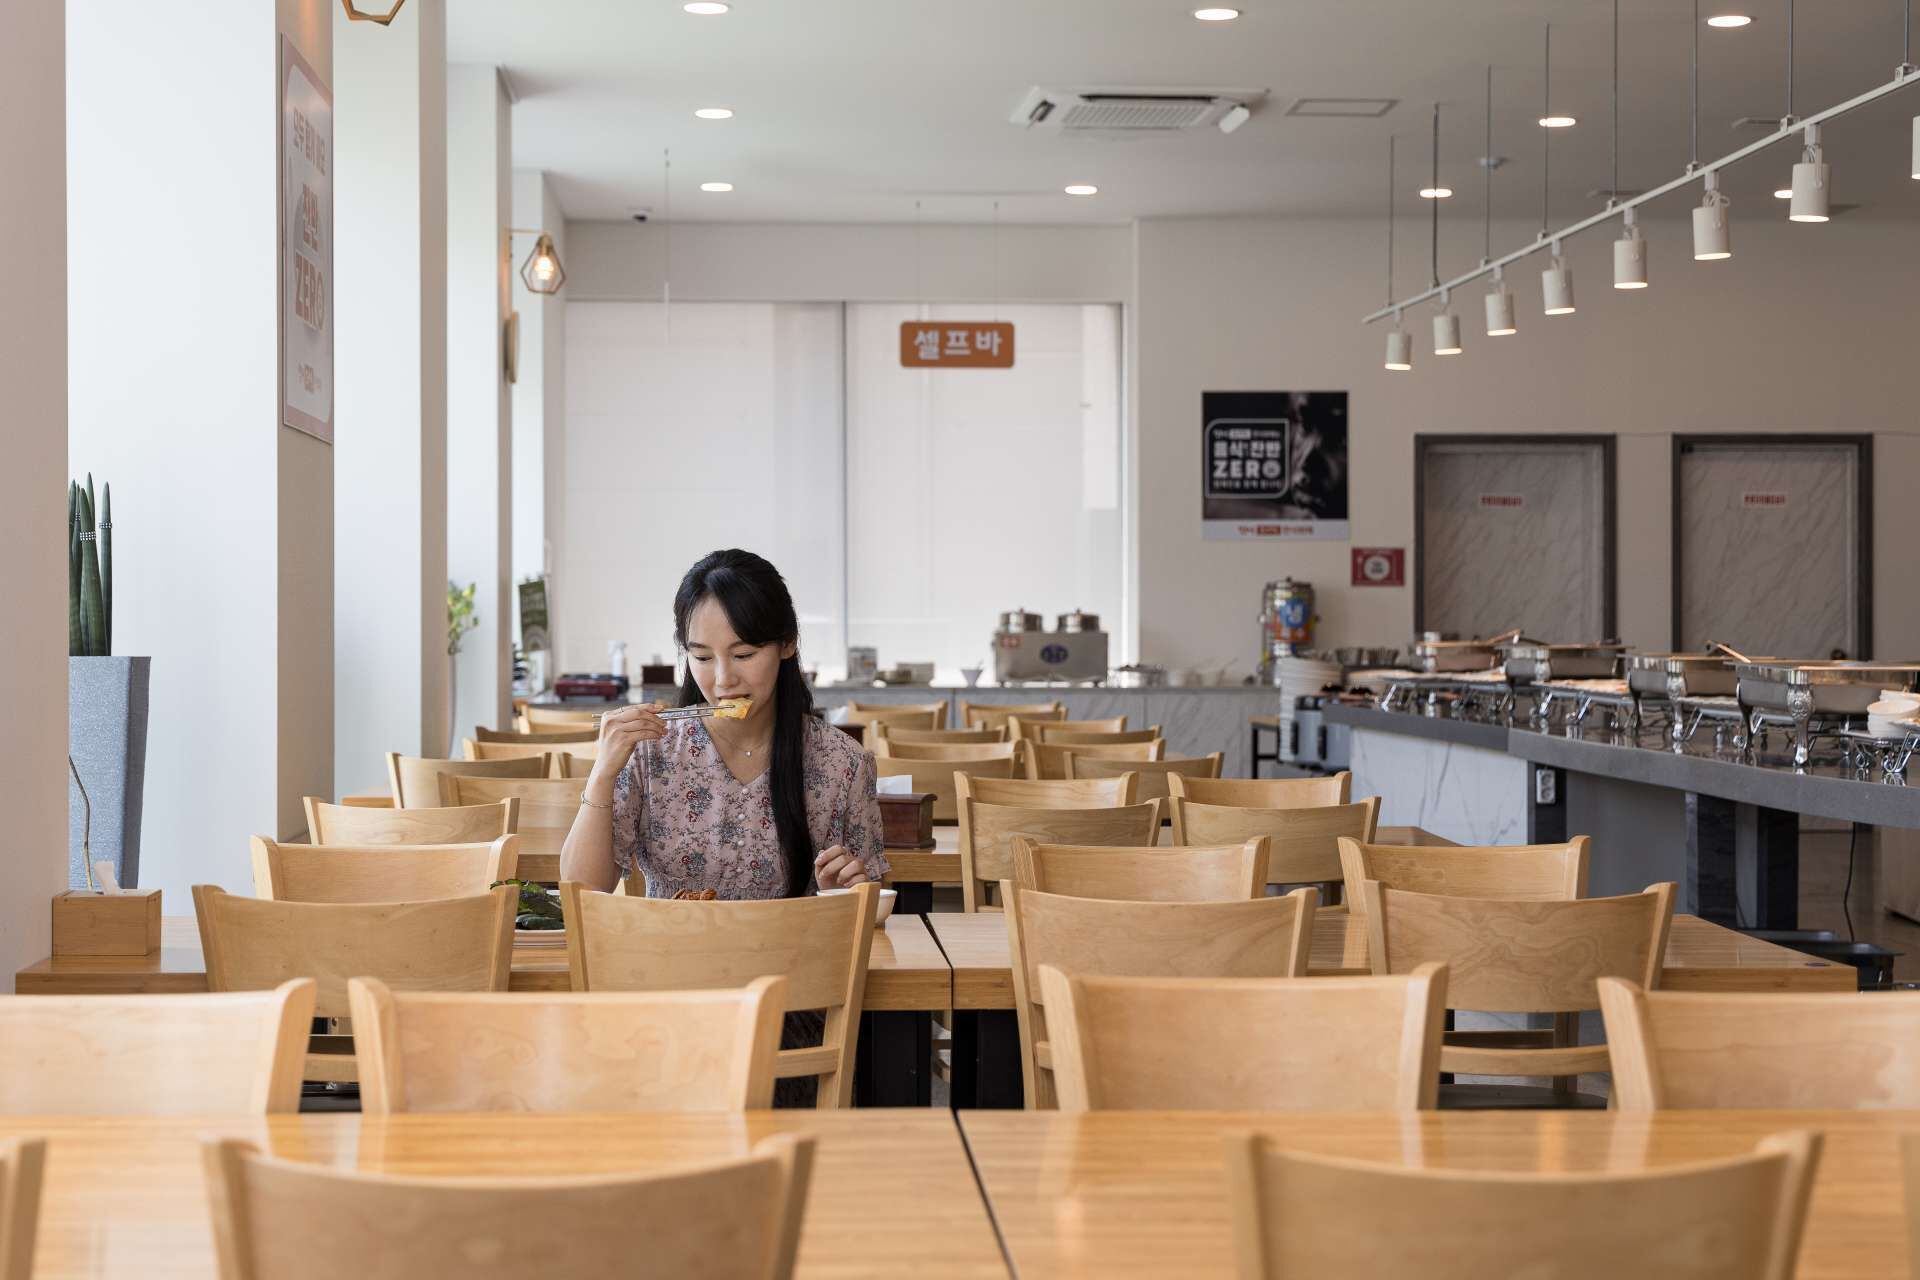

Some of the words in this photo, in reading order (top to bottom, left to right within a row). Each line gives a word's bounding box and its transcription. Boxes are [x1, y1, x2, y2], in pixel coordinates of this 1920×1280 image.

[295, 250, 325, 329] ZERO
[913, 329, 1003, 360] 셀프바
[1213, 459, 1281, 479] ZERO
